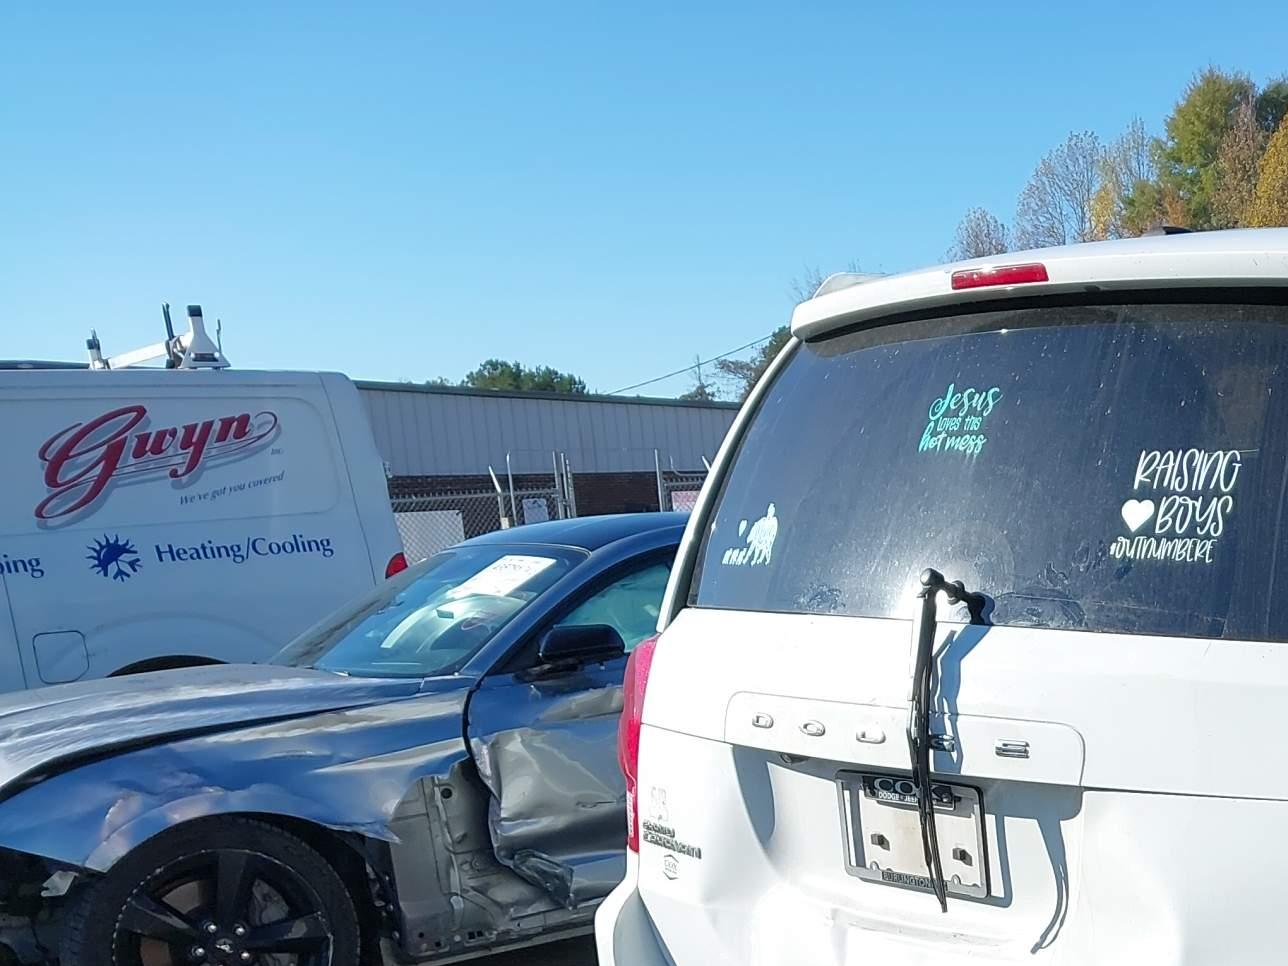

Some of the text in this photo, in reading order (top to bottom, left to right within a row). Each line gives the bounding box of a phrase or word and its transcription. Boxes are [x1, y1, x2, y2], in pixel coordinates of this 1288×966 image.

[929, 383, 1004, 420] Jesus
[918, 421, 988, 455] hot mess
[34, 404, 278, 519] Gwyn
[1133, 448, 1243, 492] RAISING
[210, 486, 227, 501] got
[228, 482, 246, 496] you
[247, 470, 286, 489] covered
[1155, 495, 1233, 537] BOYS
[154, 534, 334, 564] Heating/Cooling
